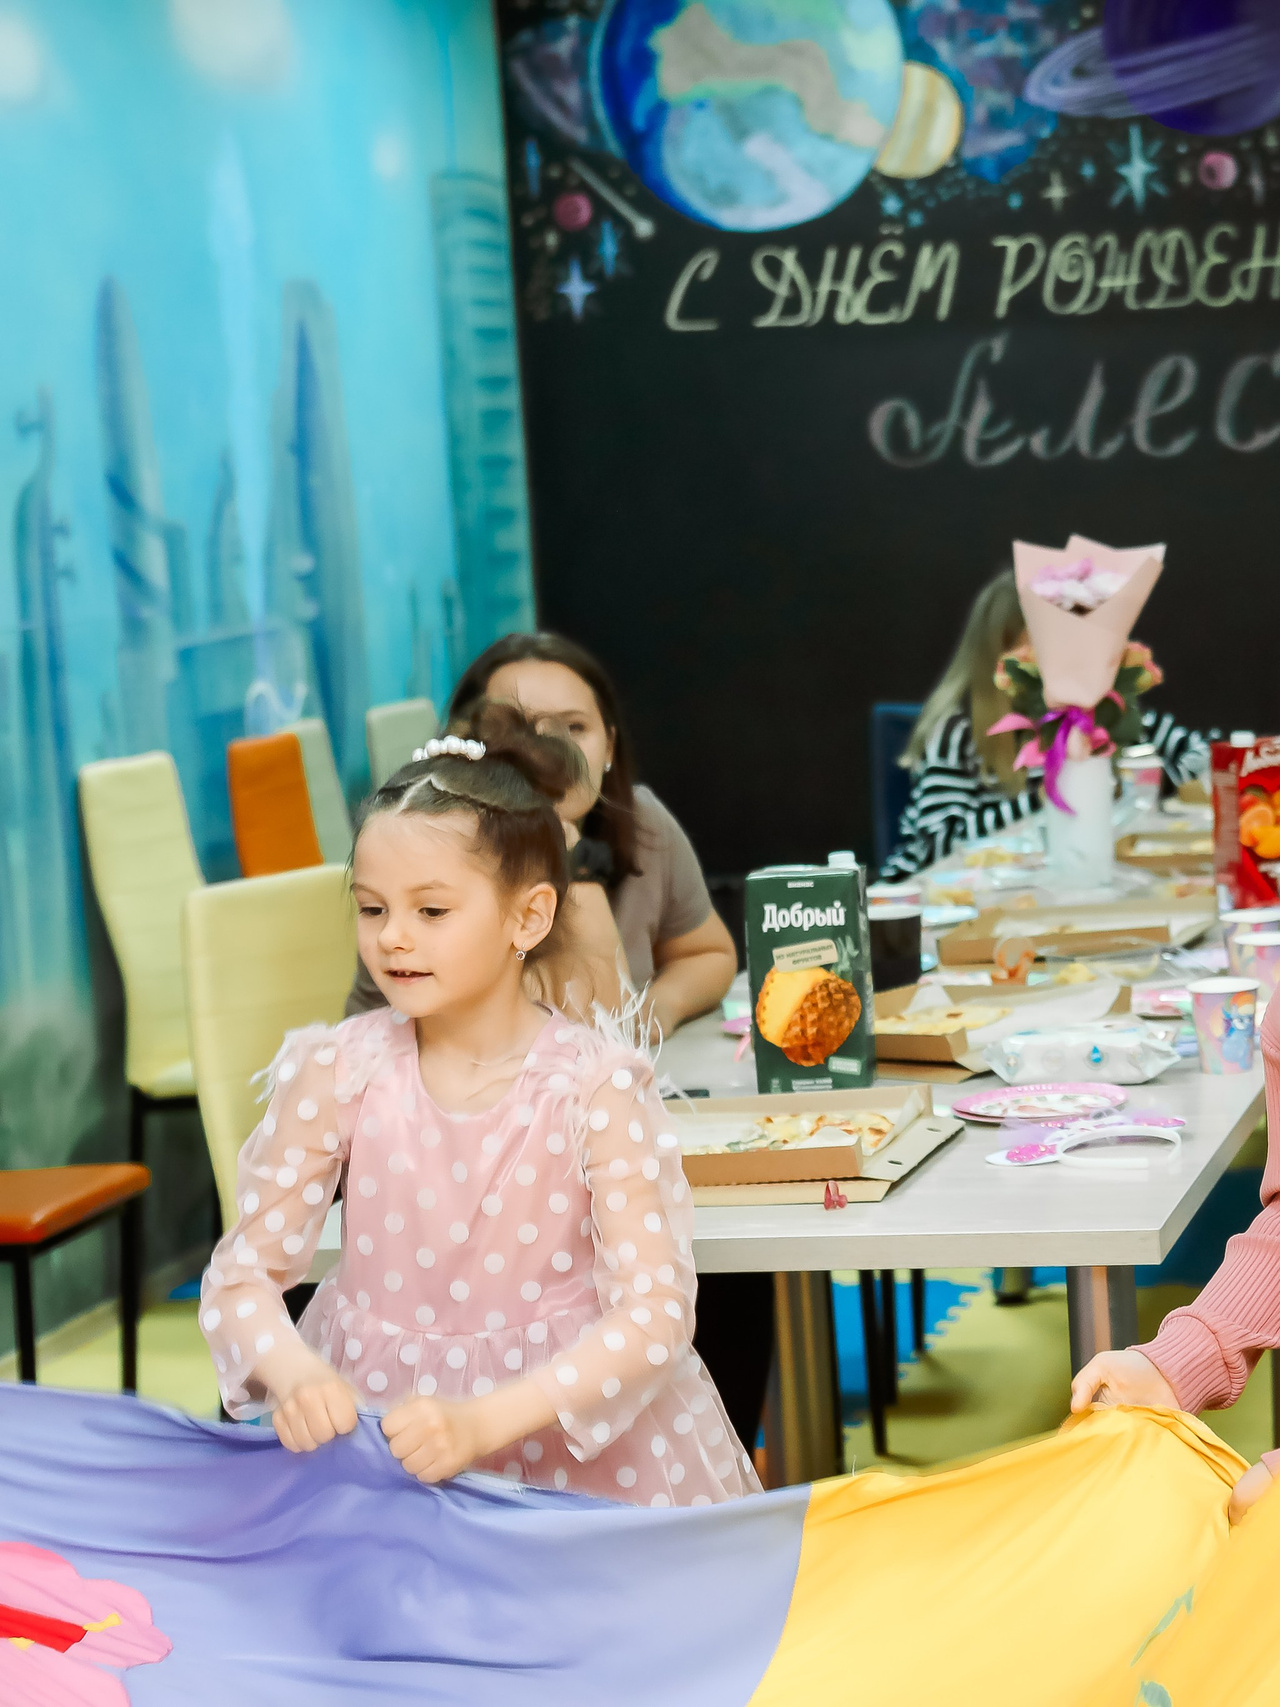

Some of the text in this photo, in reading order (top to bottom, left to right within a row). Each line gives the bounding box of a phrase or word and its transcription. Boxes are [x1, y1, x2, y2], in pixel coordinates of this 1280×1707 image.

[664, 246, 719, 332] С
[751, 225, 959, 328] ДНЁМ
[762, 900, 847, 933] Добрый
